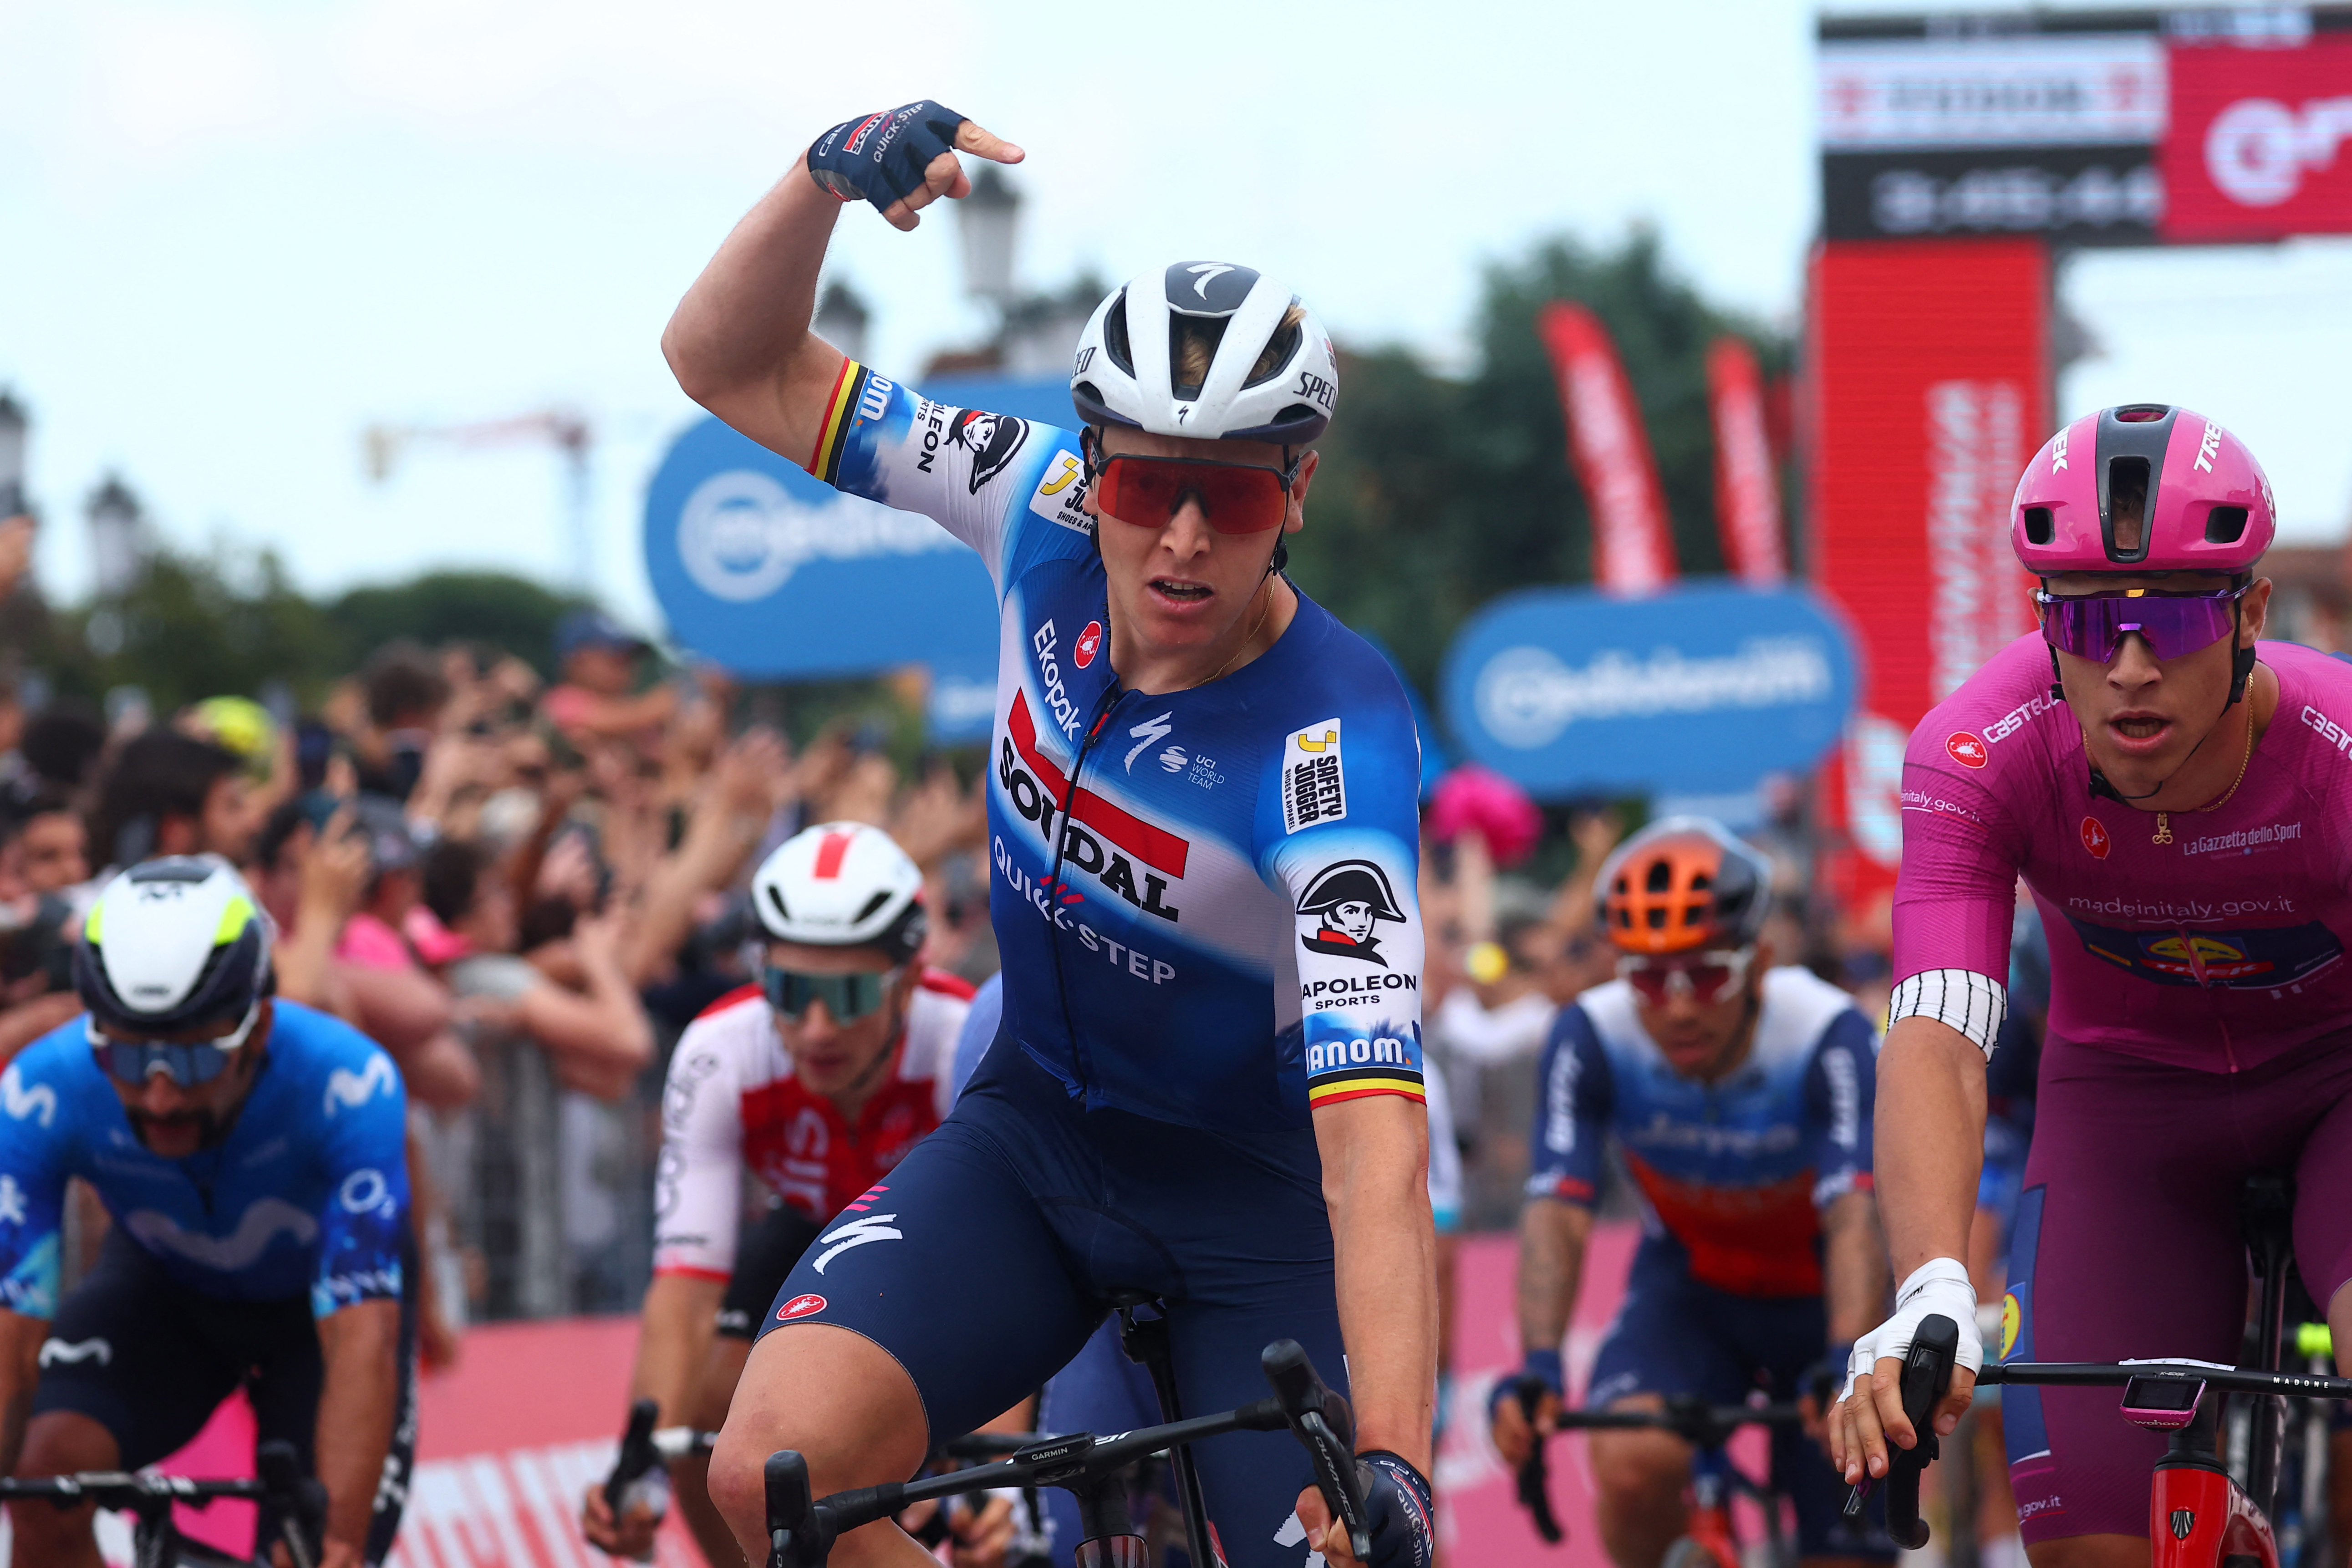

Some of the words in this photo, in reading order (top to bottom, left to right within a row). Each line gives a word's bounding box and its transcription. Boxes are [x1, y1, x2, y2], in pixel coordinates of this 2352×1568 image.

[2052, 423, 2071, 475] REK
[2193, 419, 2224, 474] TRE
[1057, 511, 1078, 525] SHOES
[1192, 763, 1225, 784] WORLD
[1196, 754, 1217, 769] UCI
[1188, 772, 1213, 790] TEAM
[1294, 759, 1320, 825] JOGGER
[1316, 755, 1342, 817] SAFETY
[1285, 800, 1295, 830] APPAREL
[2183, 841, 2198, 855] La
[2199, 830, 2246, 852] Gazzetta
[2248, 826, 2273, 845] dello
[2274, 821, 2301, 843] Sport
[2069, 896, 2295, 918] madeinitaly.gov.it
[1302, 973, 1416, 1000] APOLEON
[1315, 995, 1380, 1010] SPORTS
[2273, 1377, 2329, 1389] MADONE
[1031, 1447, 1068, 1461] GARMIN
[1315, 1436, 1356, 1526] DURA-ACE
